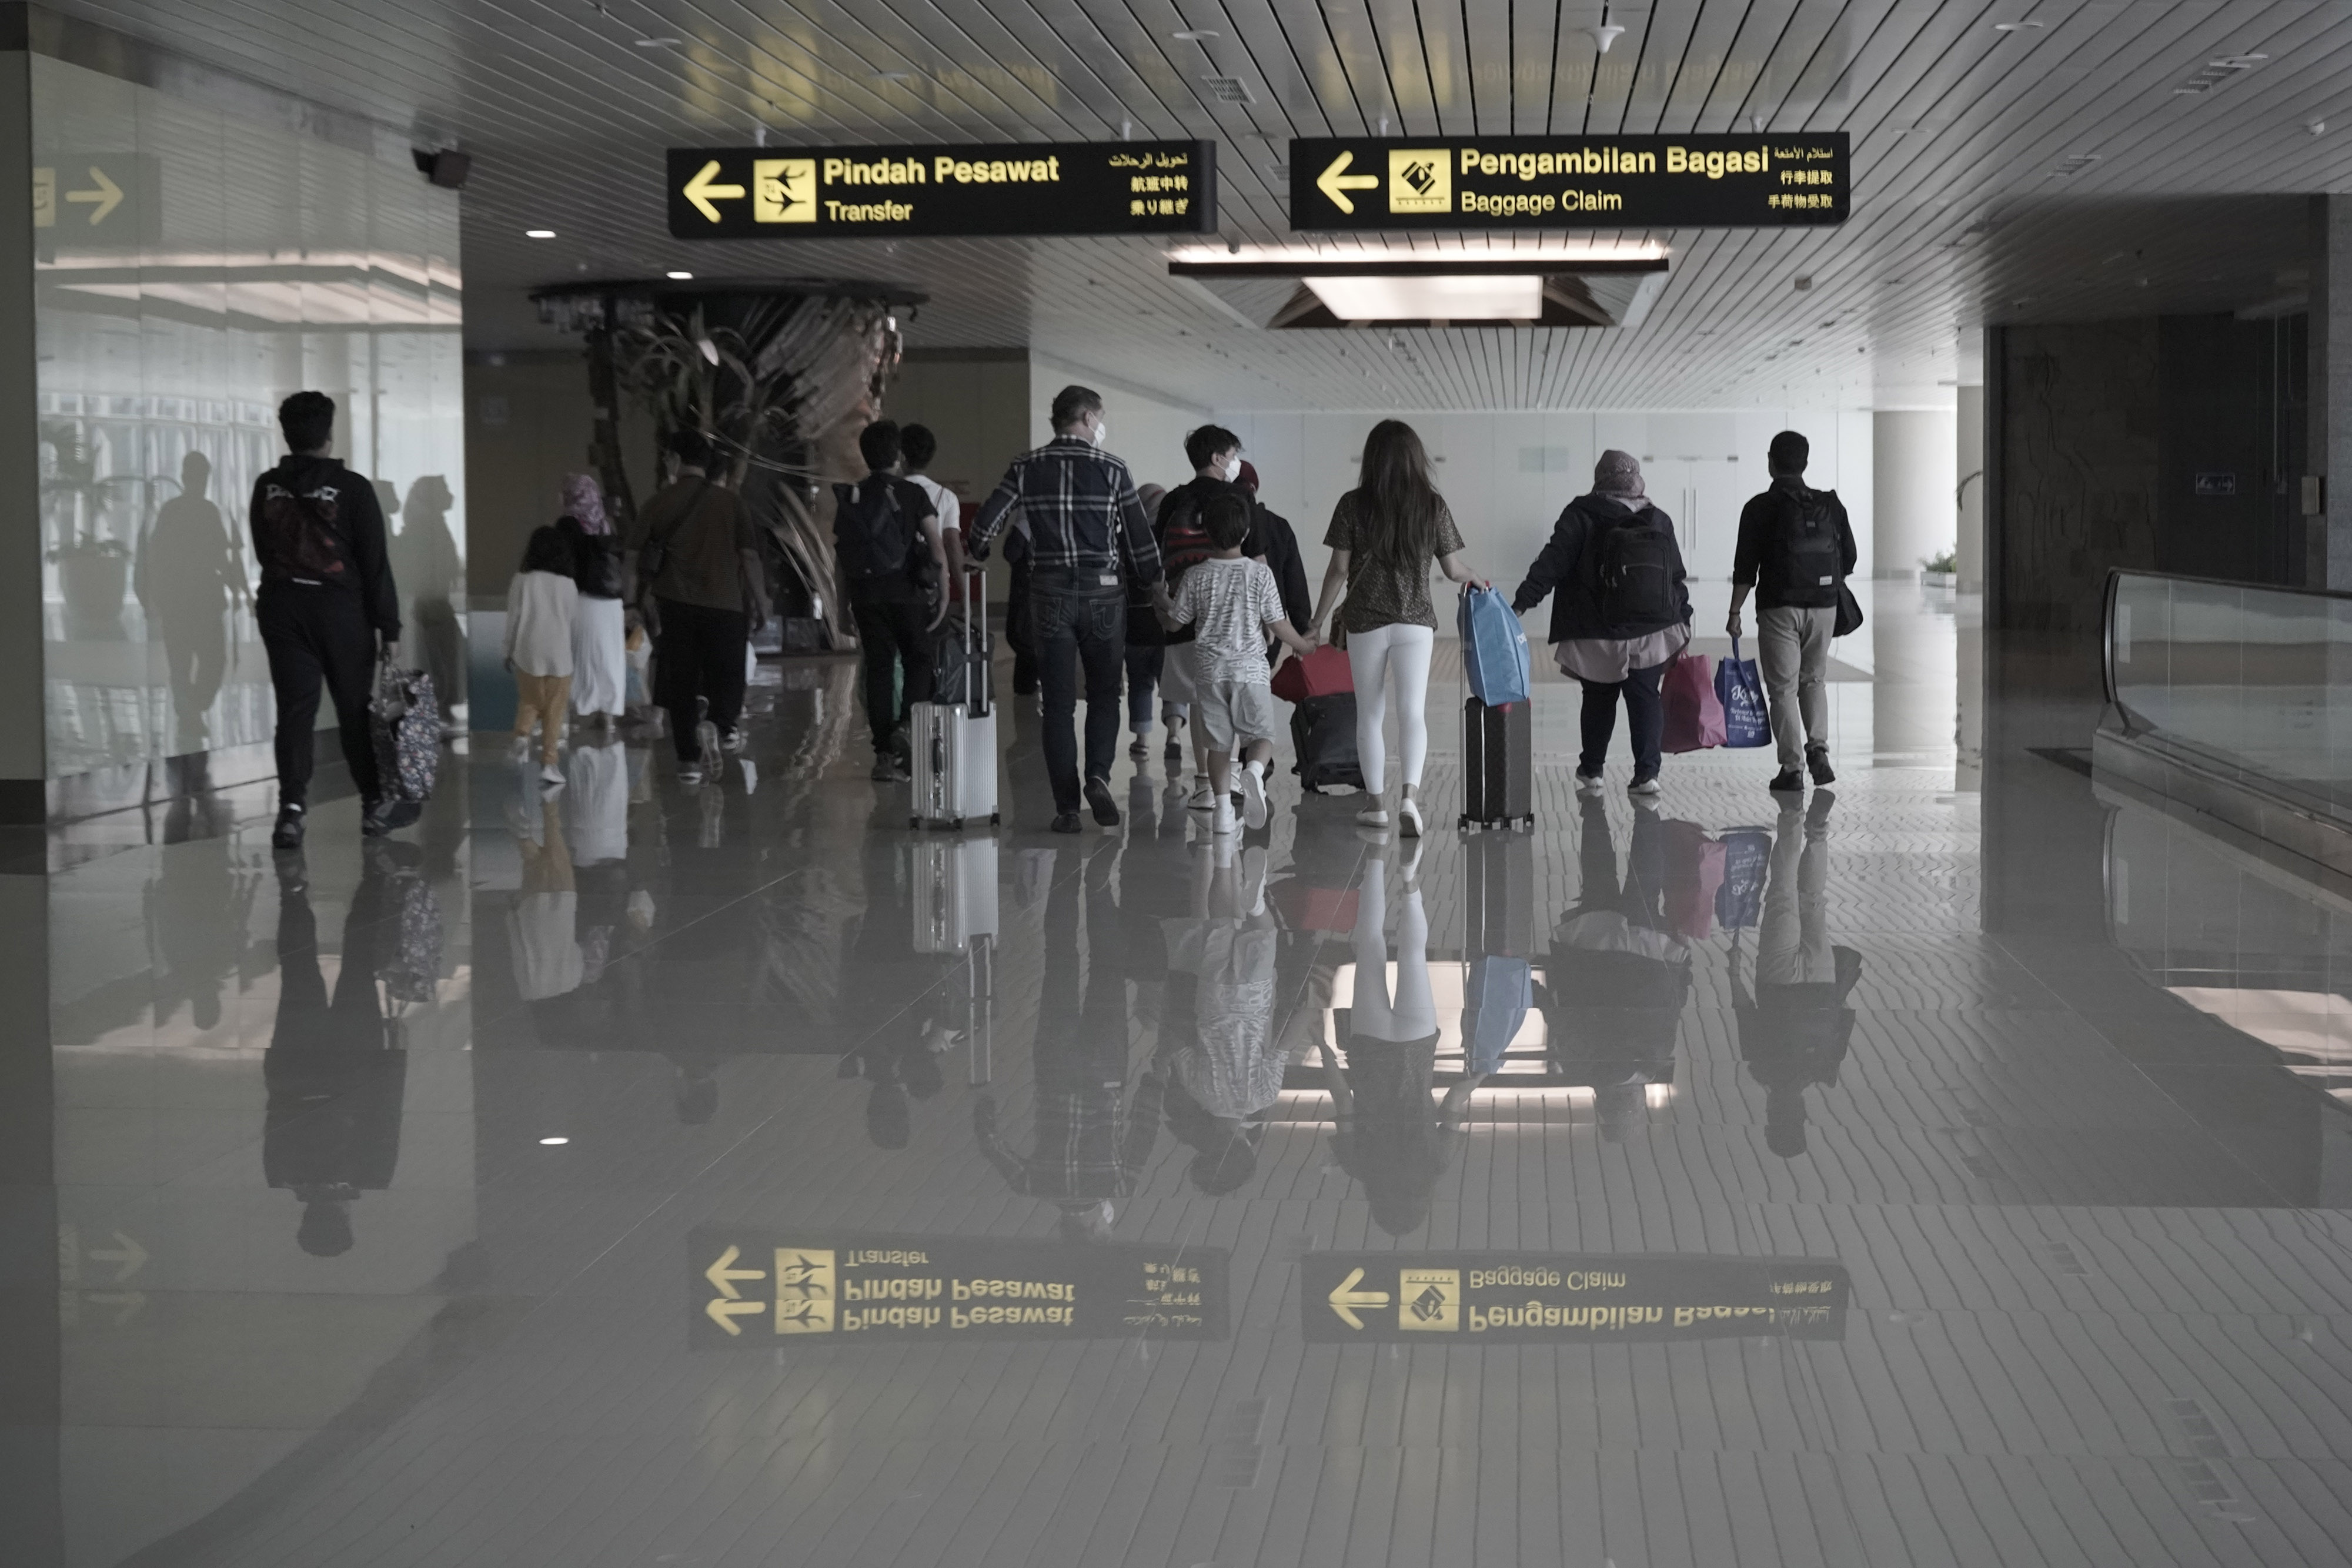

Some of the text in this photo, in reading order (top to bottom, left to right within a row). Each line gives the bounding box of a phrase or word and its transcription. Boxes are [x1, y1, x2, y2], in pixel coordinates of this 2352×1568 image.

[824, 155, 1060, 185] Pindah Pesawat
[1108, 151, 1188, 169] تحويل الرحلات
[1461, 145, 1769, 180] Pengambilan Bagasi
[824, 200, 913, 222] Transfer
[1461, 189, 1622, 216] Baggage Claim
